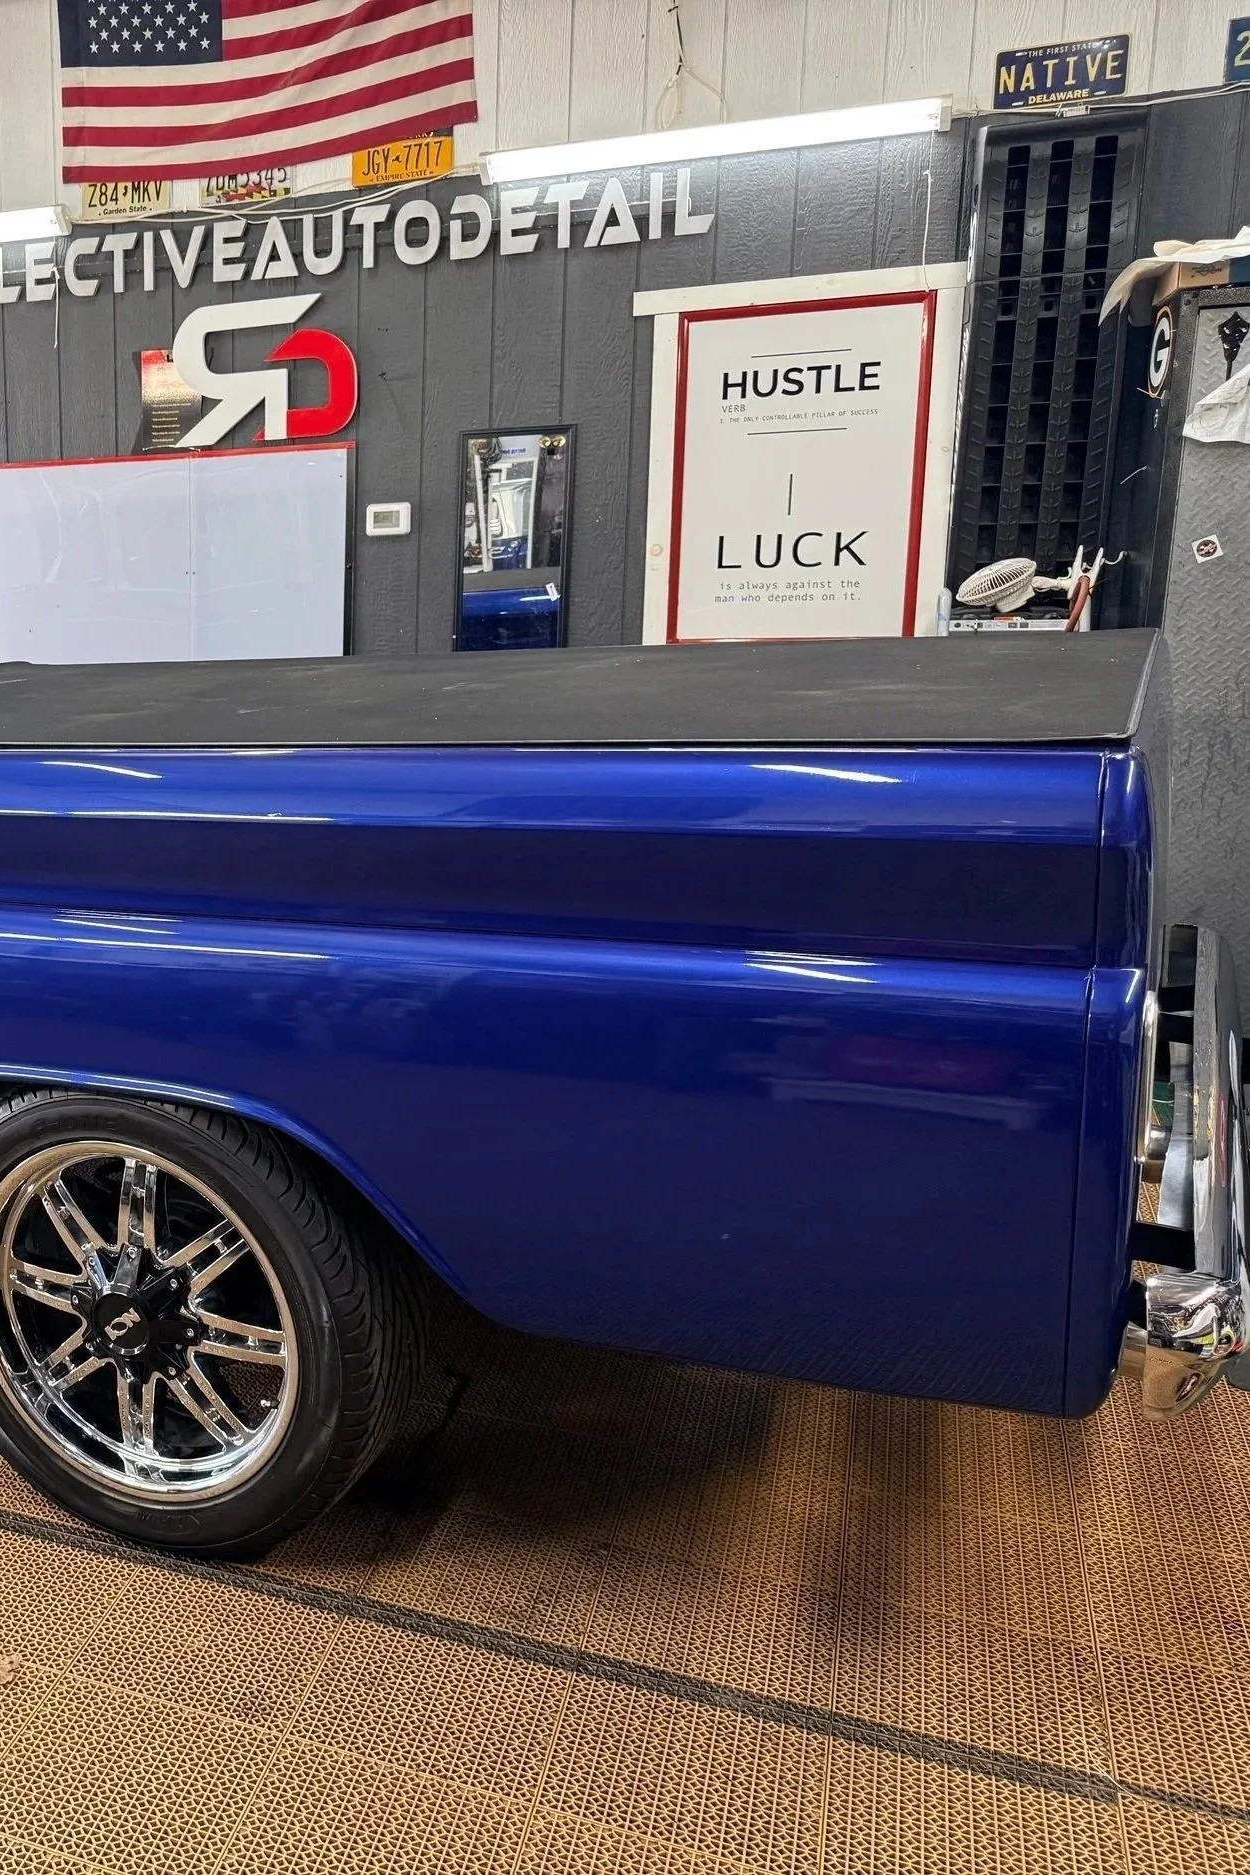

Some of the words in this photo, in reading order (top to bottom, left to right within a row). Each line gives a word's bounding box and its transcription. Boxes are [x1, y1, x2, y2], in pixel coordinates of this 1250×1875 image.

[1028, 50, 1044, 58] THE
[1046, 46, 1069, 55] FIRST
[1071, 42, 1098, 52] STATE
[999, 50, 1124, 94] NATIVE
[1028, 88, 1090, 104] DELAWARE
[362, 147, 391, 176] JGY
[403, 140, 443, 171] 7717
[376, 172, 405, 182] EMPIRE
[406, 169, 428, 178] STATE
[131, 180, 164, 203] MKV
[103, 206, 127, 216] Garden
[129, 205, 147, 214] State
[722, 361, 881, 400] HUSTLE
[722, 404, 746, 414] VERB
[762, 412, 808, 422] CONTROLLABLE
[811, 411, 835, 419] PILLAR
[850, 408, 879, 417] SUCCESS
[717, 530, 869, 569] LUCK
[720, 582, 732, 590] is
[739, 581, 778, 592] always
[785, 580, 832, 591] against
[841, 579, 861, 589] the
[714, 594, 735, 603] man
[741, 593, 761, 602] who
[767, 592, 815, 604] depends
[822, 593, 835, 602] on
[843, 591, 862, 601] it.
